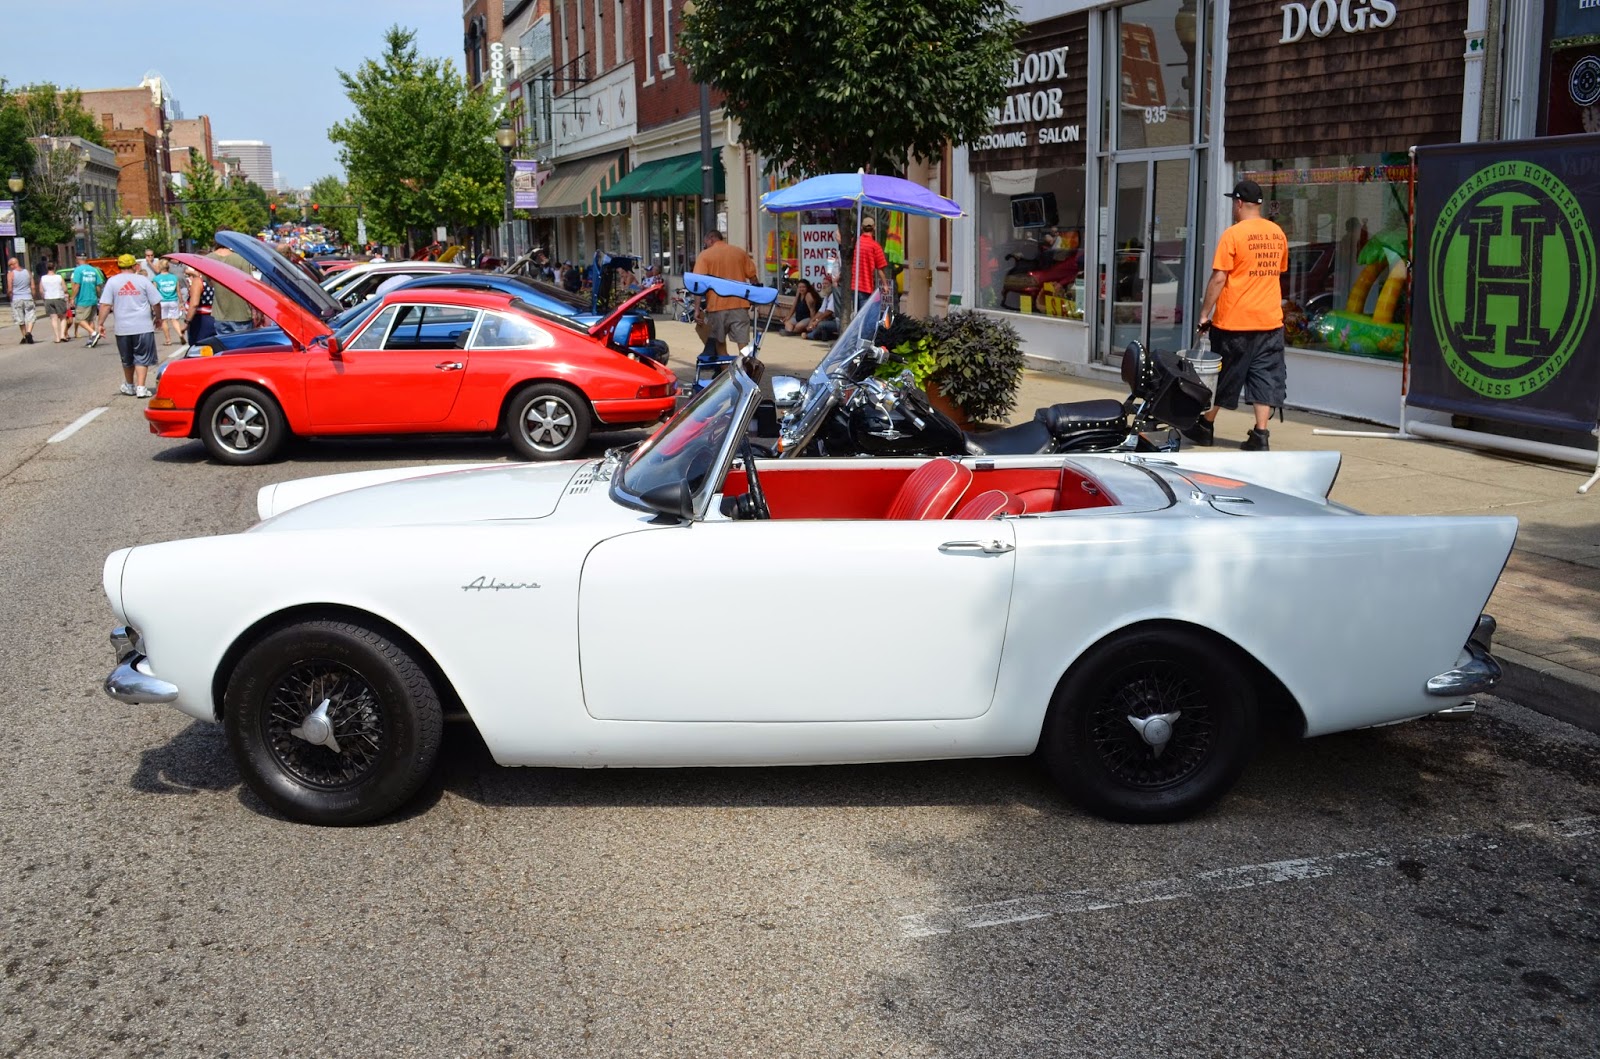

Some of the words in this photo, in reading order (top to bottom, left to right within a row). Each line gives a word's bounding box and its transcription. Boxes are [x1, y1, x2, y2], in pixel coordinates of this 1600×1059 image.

[1278, 0, 1397, 43] DOGS
[1003, 46, 1069, 88] LODY
[1144, 105, 1168, 125] 935
[1038, 124, 1080, 145] SALON
[1439, 163, 1517, 229] #OPERATION
[1523, 164, 1584, 231] HOMELESS
[803, 230, 834, 242] WORK
[803, 248, 837, 259] PANTS
[1248, 242, 1276, 251] CAMPBELL
[1255, 252, 1280, 260] INMATE
[805, 265, 811, 277] 5
[814, 265, 828, 277] PA
[1442, 344, 1448, 356] A
[1450, 359, 1511, 396] SELFLESS
[1519, 355, 1563, 393] TREND
[461, 575, 541, 592] Alpine
